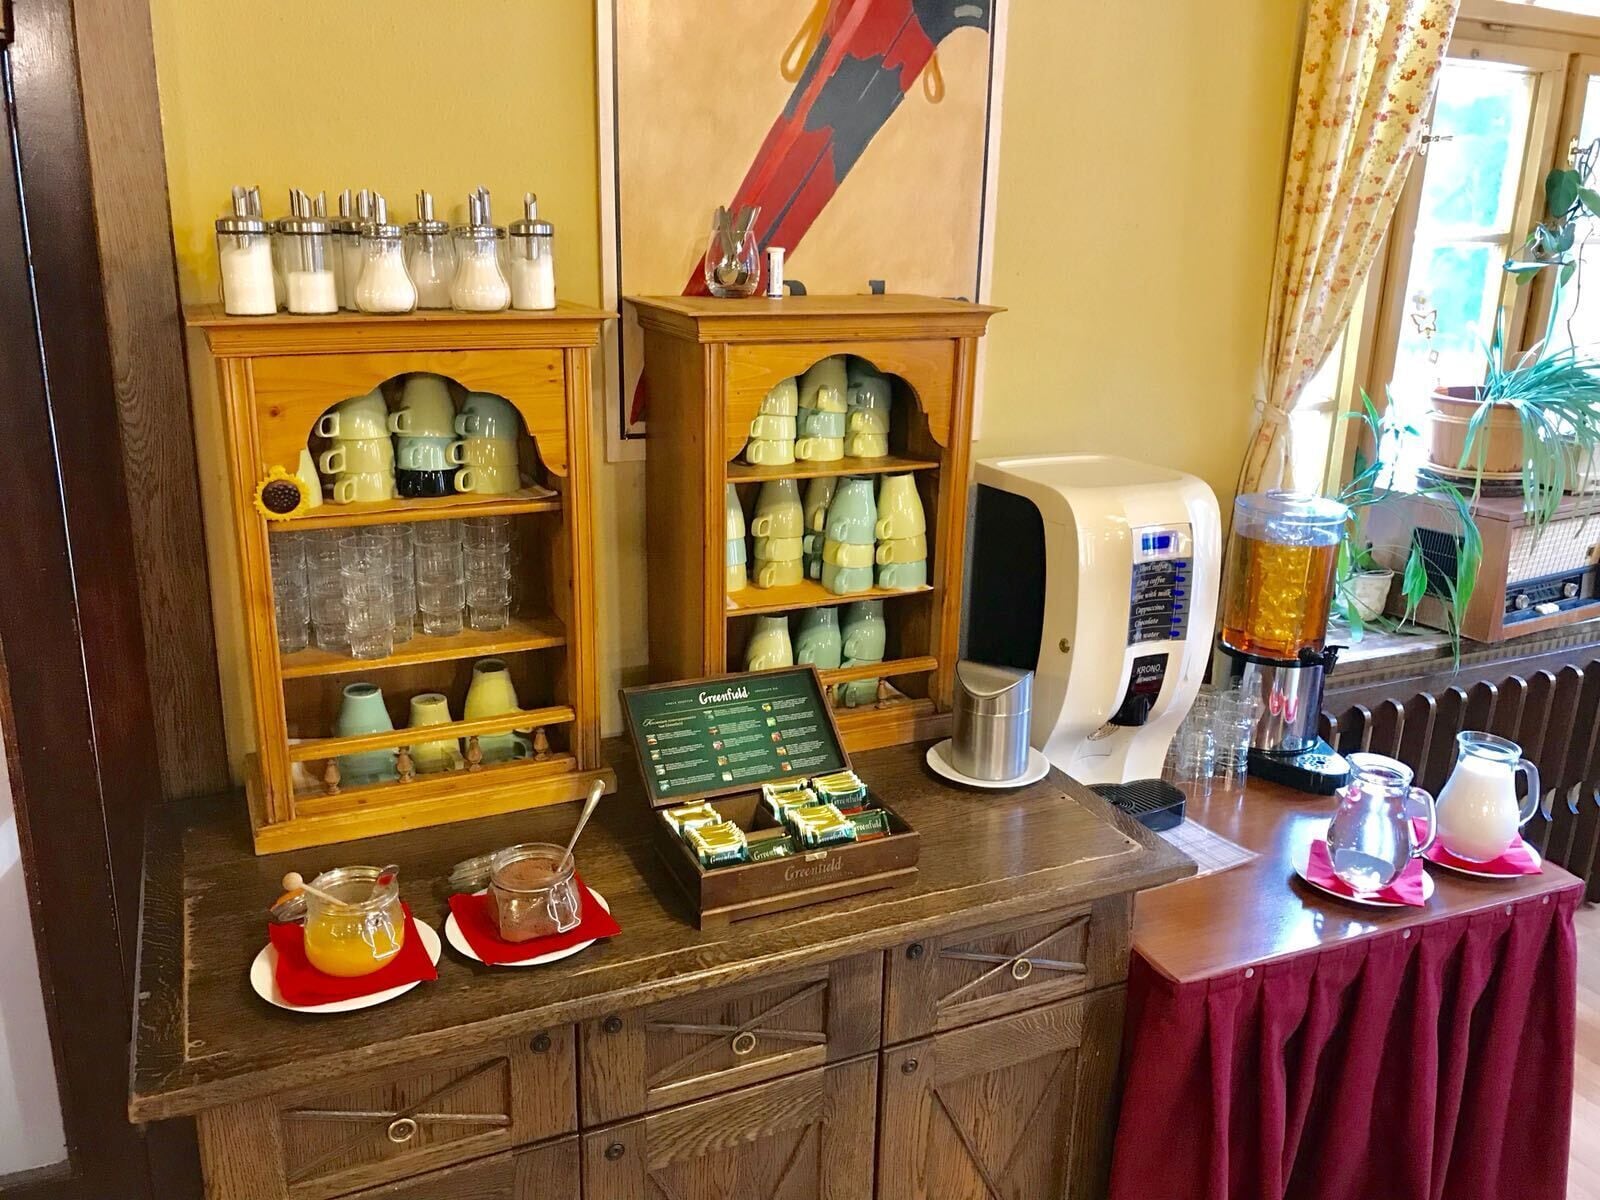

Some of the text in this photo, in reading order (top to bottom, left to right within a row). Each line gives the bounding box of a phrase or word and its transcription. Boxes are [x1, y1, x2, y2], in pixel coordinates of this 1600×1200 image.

[1152, 561, 1169, 573] coffee
[1149, 575, 1166, 587] coffee
[1135, 604, 1165, 616] Cappuccino
[698, 685, 749, 705] Greenfield
[831, 793, 862, 806] Greenfield
[855, 818, 882, 832] reenfield
[784, 856, 843, 881] Greenfield
